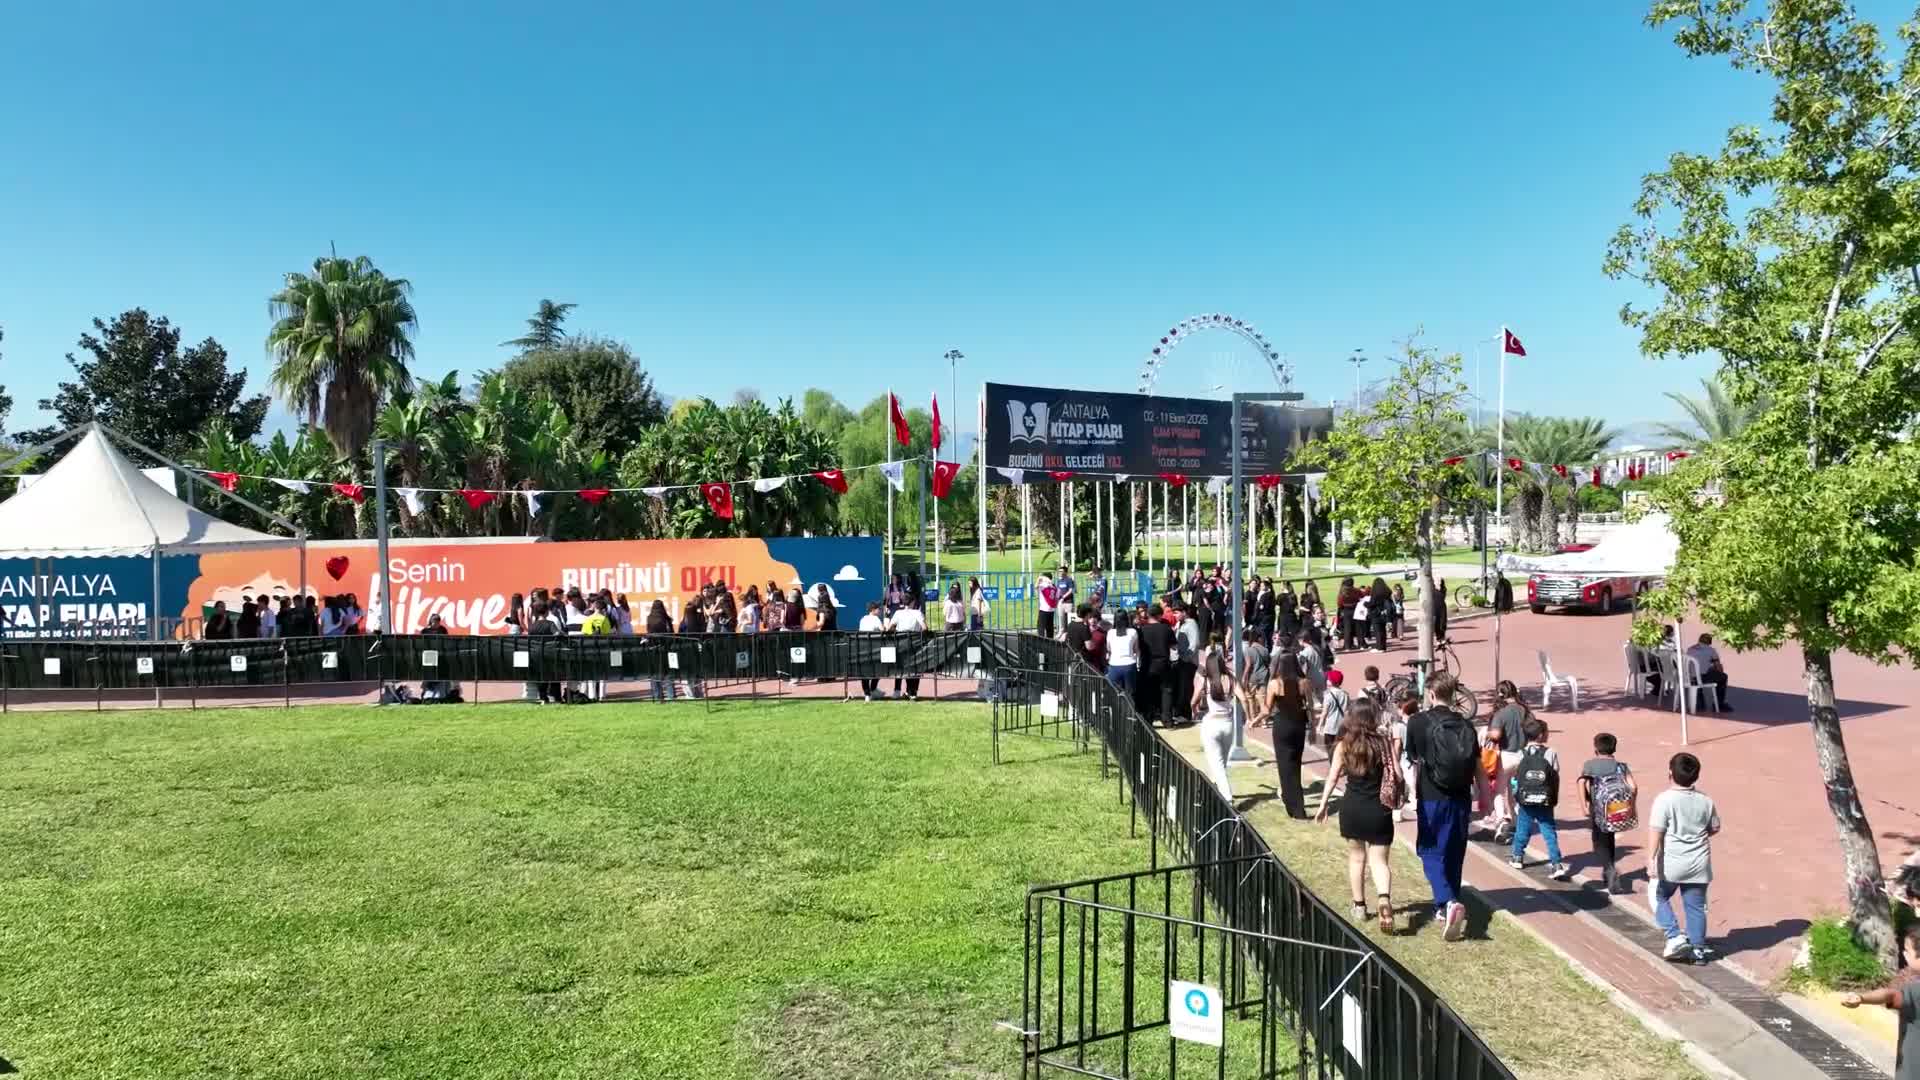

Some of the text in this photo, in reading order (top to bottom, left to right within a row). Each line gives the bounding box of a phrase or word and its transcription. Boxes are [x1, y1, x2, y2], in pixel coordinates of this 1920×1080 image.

[1061, 403, 1110, 420] ANTALYA
[1050, 419, 1123, 439] KİTAP FUARI
[1008, 453, 1043, 468] BUGÜNÜ
[1065, 453, 1105, 468] GELECEĞİ
[388, 556, 464, 583] Senin
[562, 562, 672, 593] BUGÜNÜ
[0, 573, 117, 598] ANTALYA
[2, 602, 147, 628] TAP FUARI
